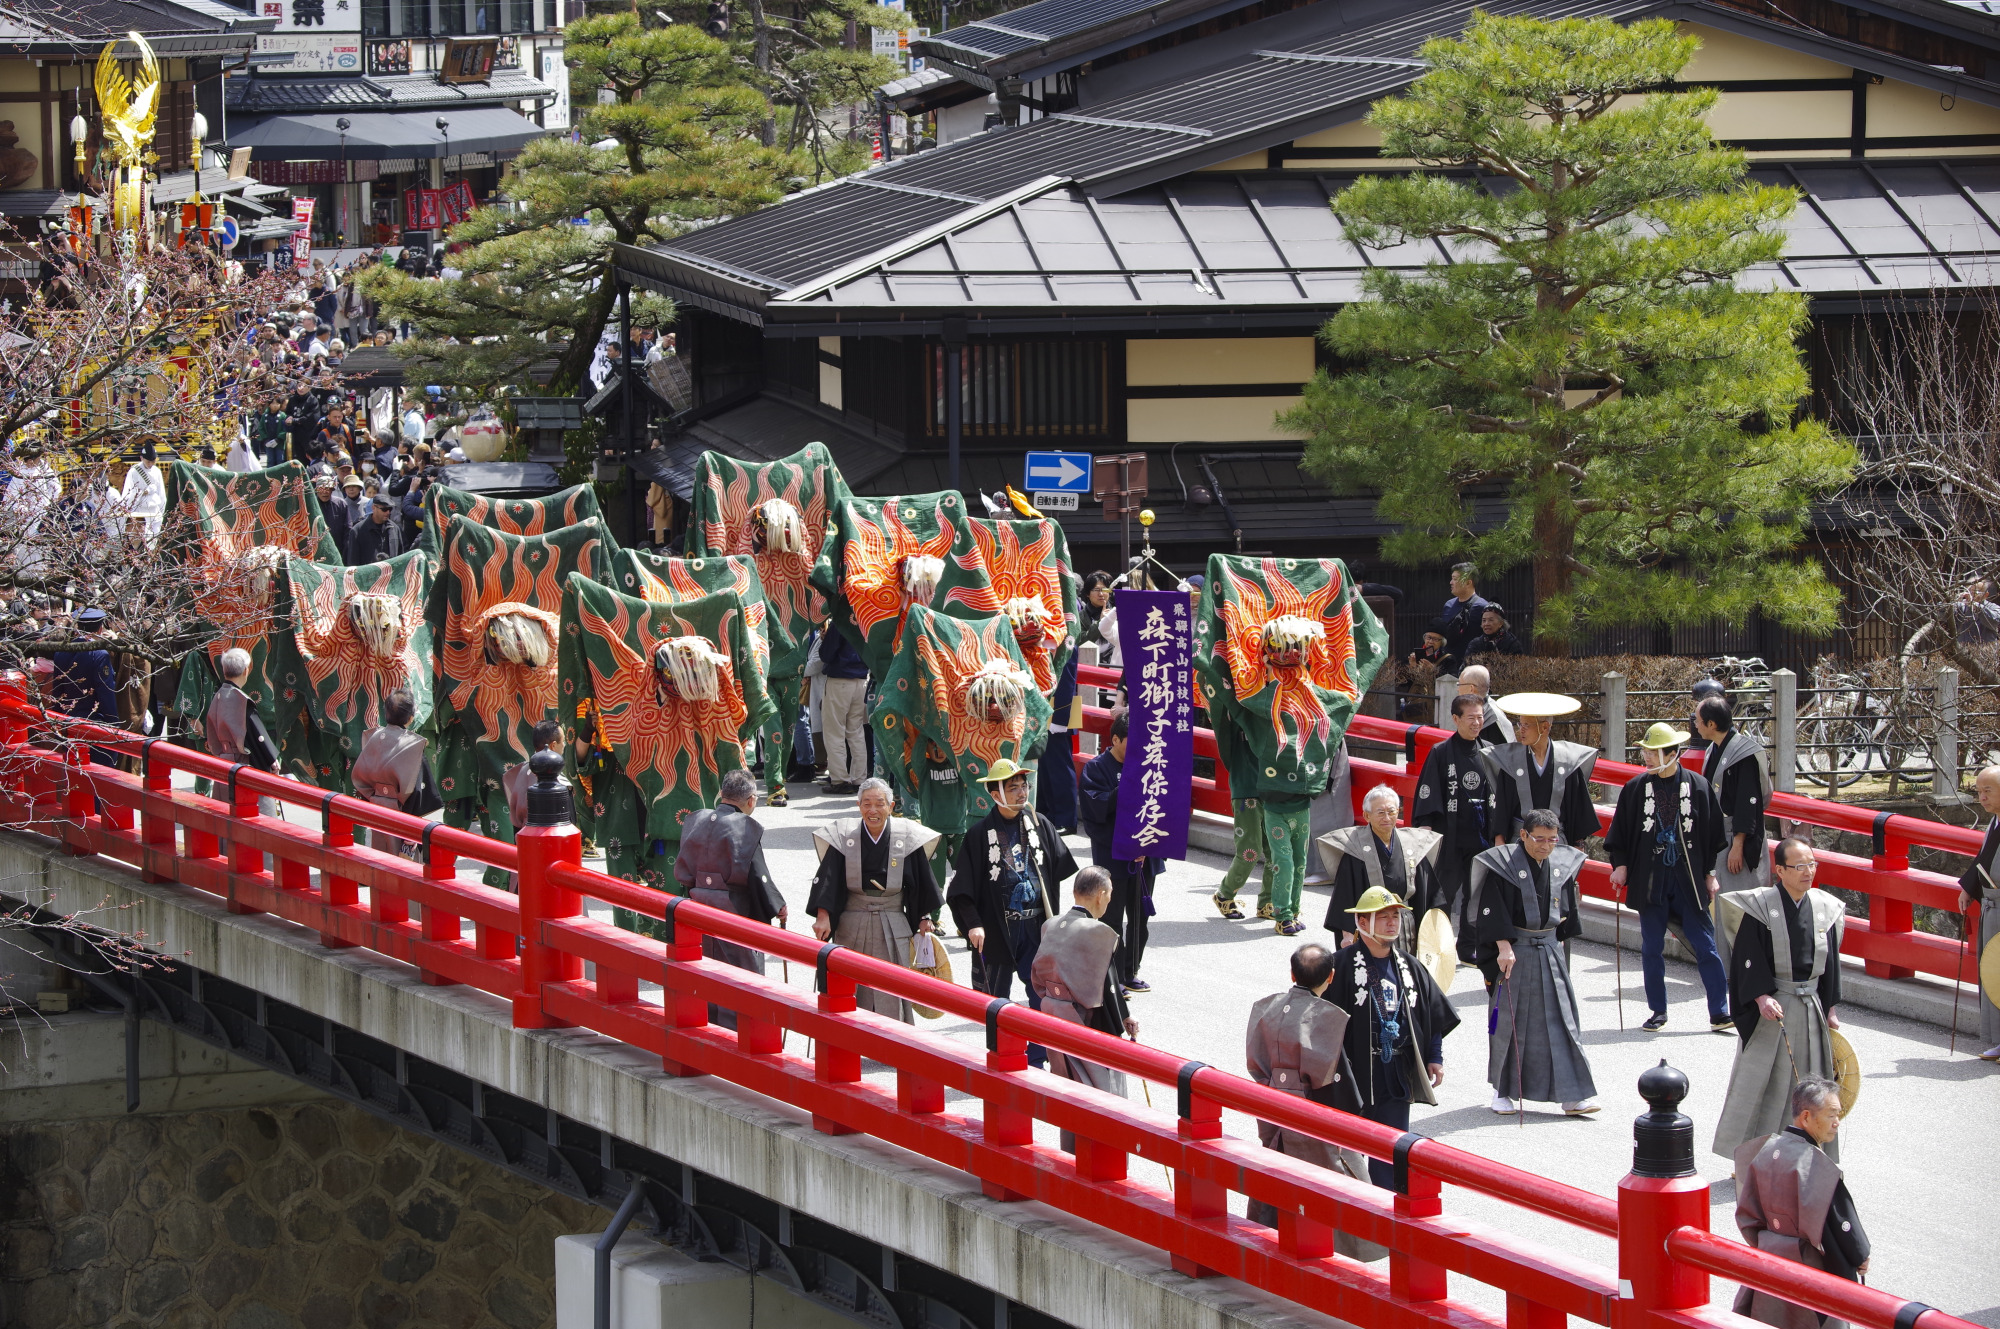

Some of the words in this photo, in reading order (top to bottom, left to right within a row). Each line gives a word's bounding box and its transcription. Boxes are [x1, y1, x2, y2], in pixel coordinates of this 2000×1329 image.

[912, 59, 923, 71] P
[1131, 605, 1175, 847] 森下町獅子舞保存会
[1173, 602, 1191, 733] 飛騨高山日枝神社
